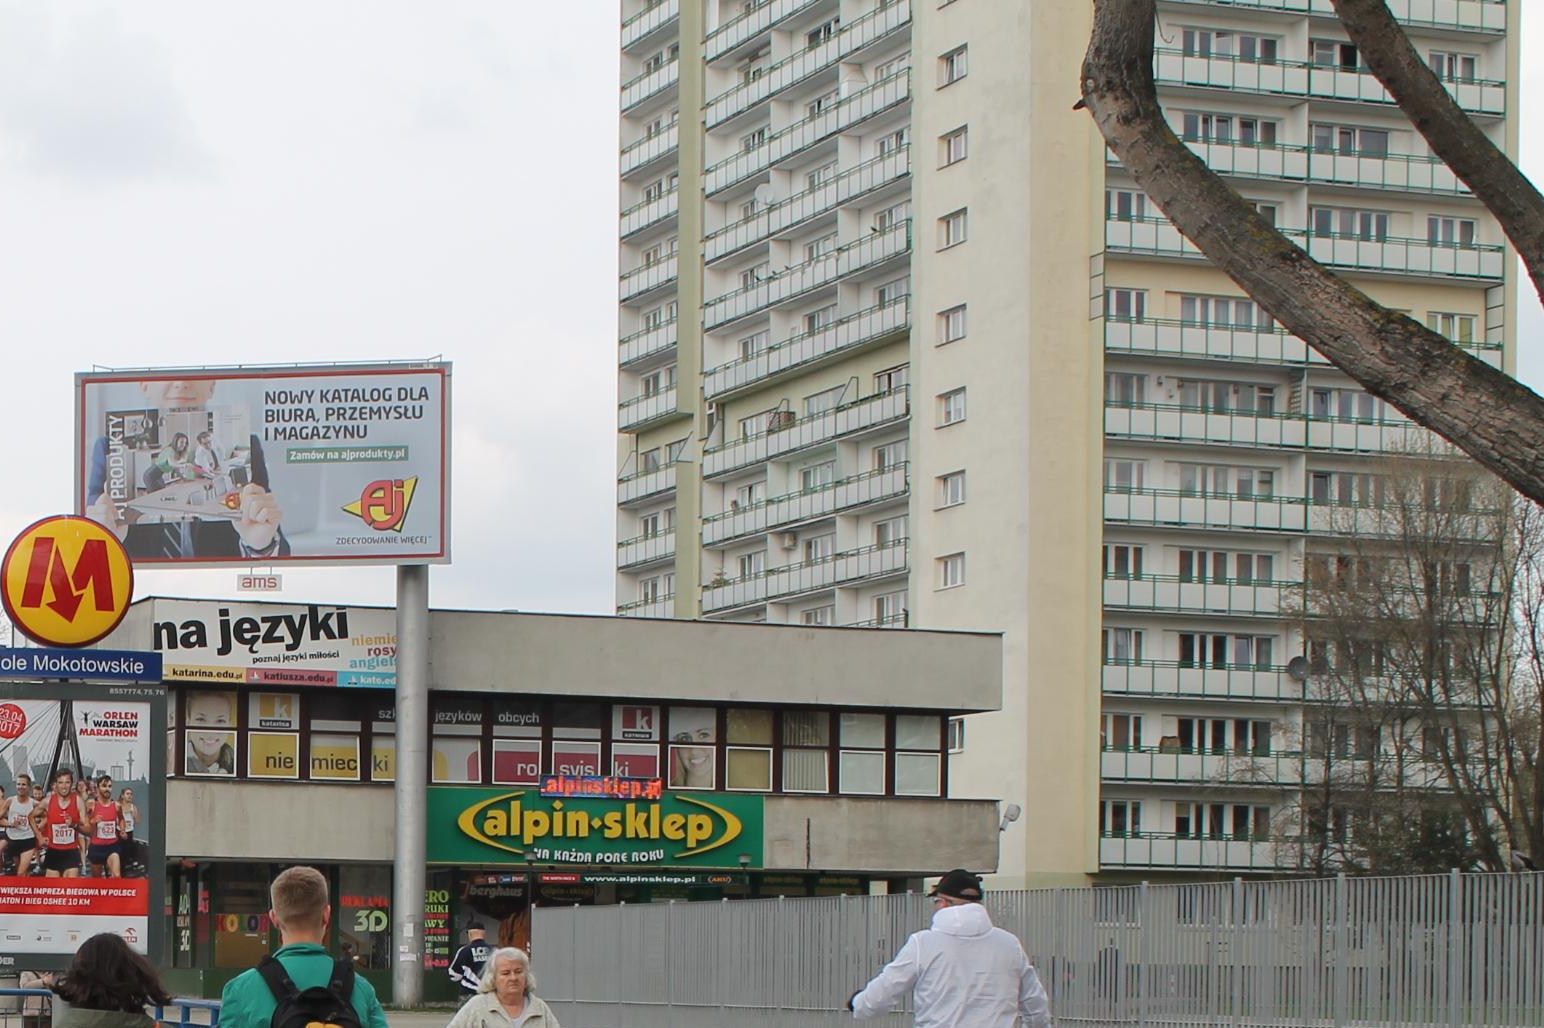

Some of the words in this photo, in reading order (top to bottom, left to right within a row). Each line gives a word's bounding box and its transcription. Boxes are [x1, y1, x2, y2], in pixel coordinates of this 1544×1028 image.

[264, 390, 315, 405] NOWY
[320, 387, 392, 403] KATALOG
[397, 386, 429, 401] DLA
[264, 408, 320, 423] BIURA,
[325, 405, 424, 422] PRZEMYSŁU
[264, 427, 269, 441] I
[274, 424, 368, 441] MAGAZYNU
[109, 415, 125, 499] PRODUKTY
[290, 450, 325, 461] Zamów
[327, 451, 339, 460] na
[341, 448, 405, 461] ajprodukty.pl
[335, 536, 399, 545] ZDECYDOWANIE
[242, 576, 277, 588] ams
[153, 617, 208, 650] na
[216, 605, 349, 656] języki
[252, 654, 281, 664] poznaj
[282, 653, 307, 663] języki
[309, 650, 340, 660] miłości
[33, 655, 144, 674] Mokotowskie
[172, 668, 243, 680] katarina.edu.pl
[103, 711, 138, 720] ORLEN
[435, 710, 482, 723] języków
[498, 712, 540, 725] obcych
[93, 720, 138, 728] WARSAW
[79, 728, 138, 737] MARATHON
[266, 752, 294, 768] nie
[311, 751, 358, 770] miec
[373, 754, 388, 771] ki
[516, 761, 538, 776] ro
[615, 760, 630, 777] ki
[56, 829, 73, 838] 2017
[632, 849, 664, 862] ROKU
[584, 876, 696, 884] www.alpinsklep.pl
[33, 887, 65, 895] IMPREZA
[66, 888, 99, 896] BIEGOWA
[108, 889, 137, 897] POLSCE
[469, 884, 523, 898] berghaus
[79, 898, 91, 906] KM
[354, 910, 388, 932] 3D
